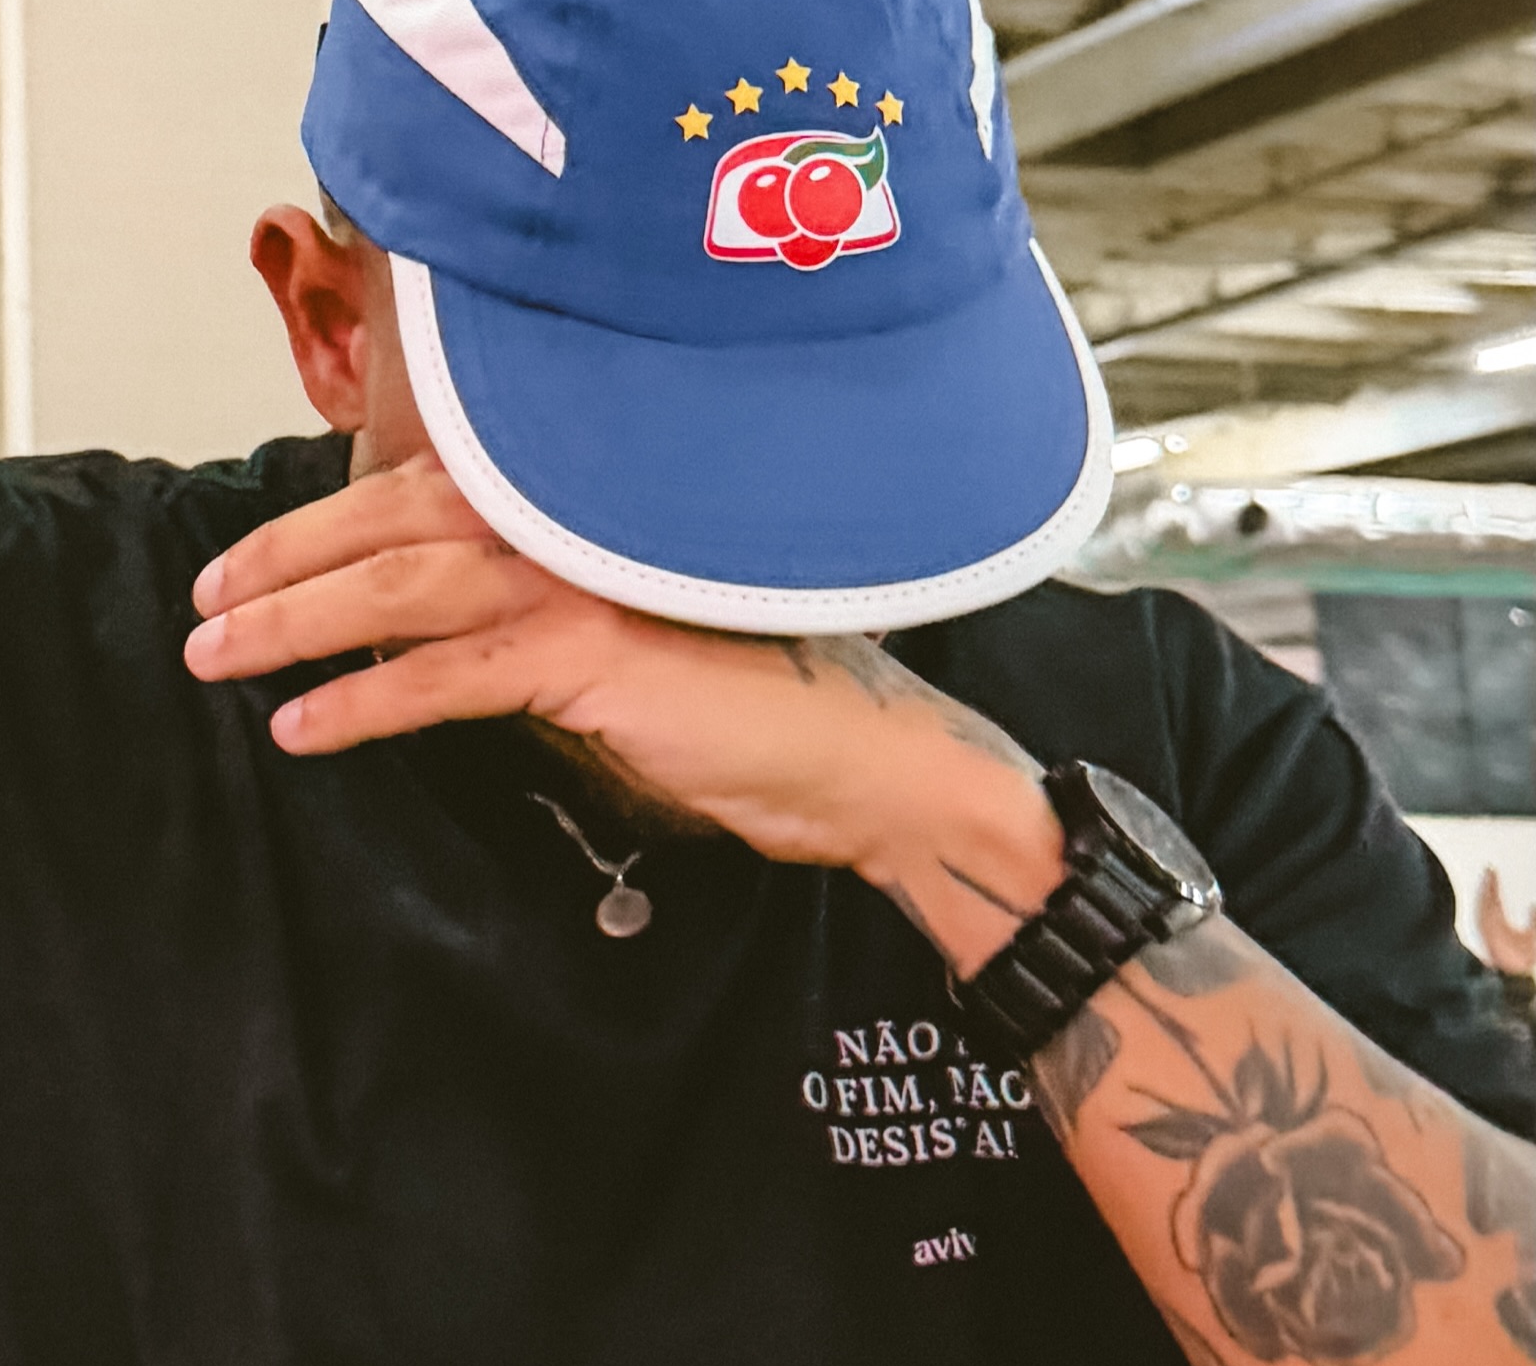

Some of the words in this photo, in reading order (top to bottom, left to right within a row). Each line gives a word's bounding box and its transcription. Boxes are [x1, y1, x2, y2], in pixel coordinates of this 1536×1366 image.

[833, 1019, 941, 1067] NÃO
[802, 1071, 829, 1112] O
[832, 1074, 939, 1116] FIM,
[827, 1116, 1020, 1167] DESISA!
